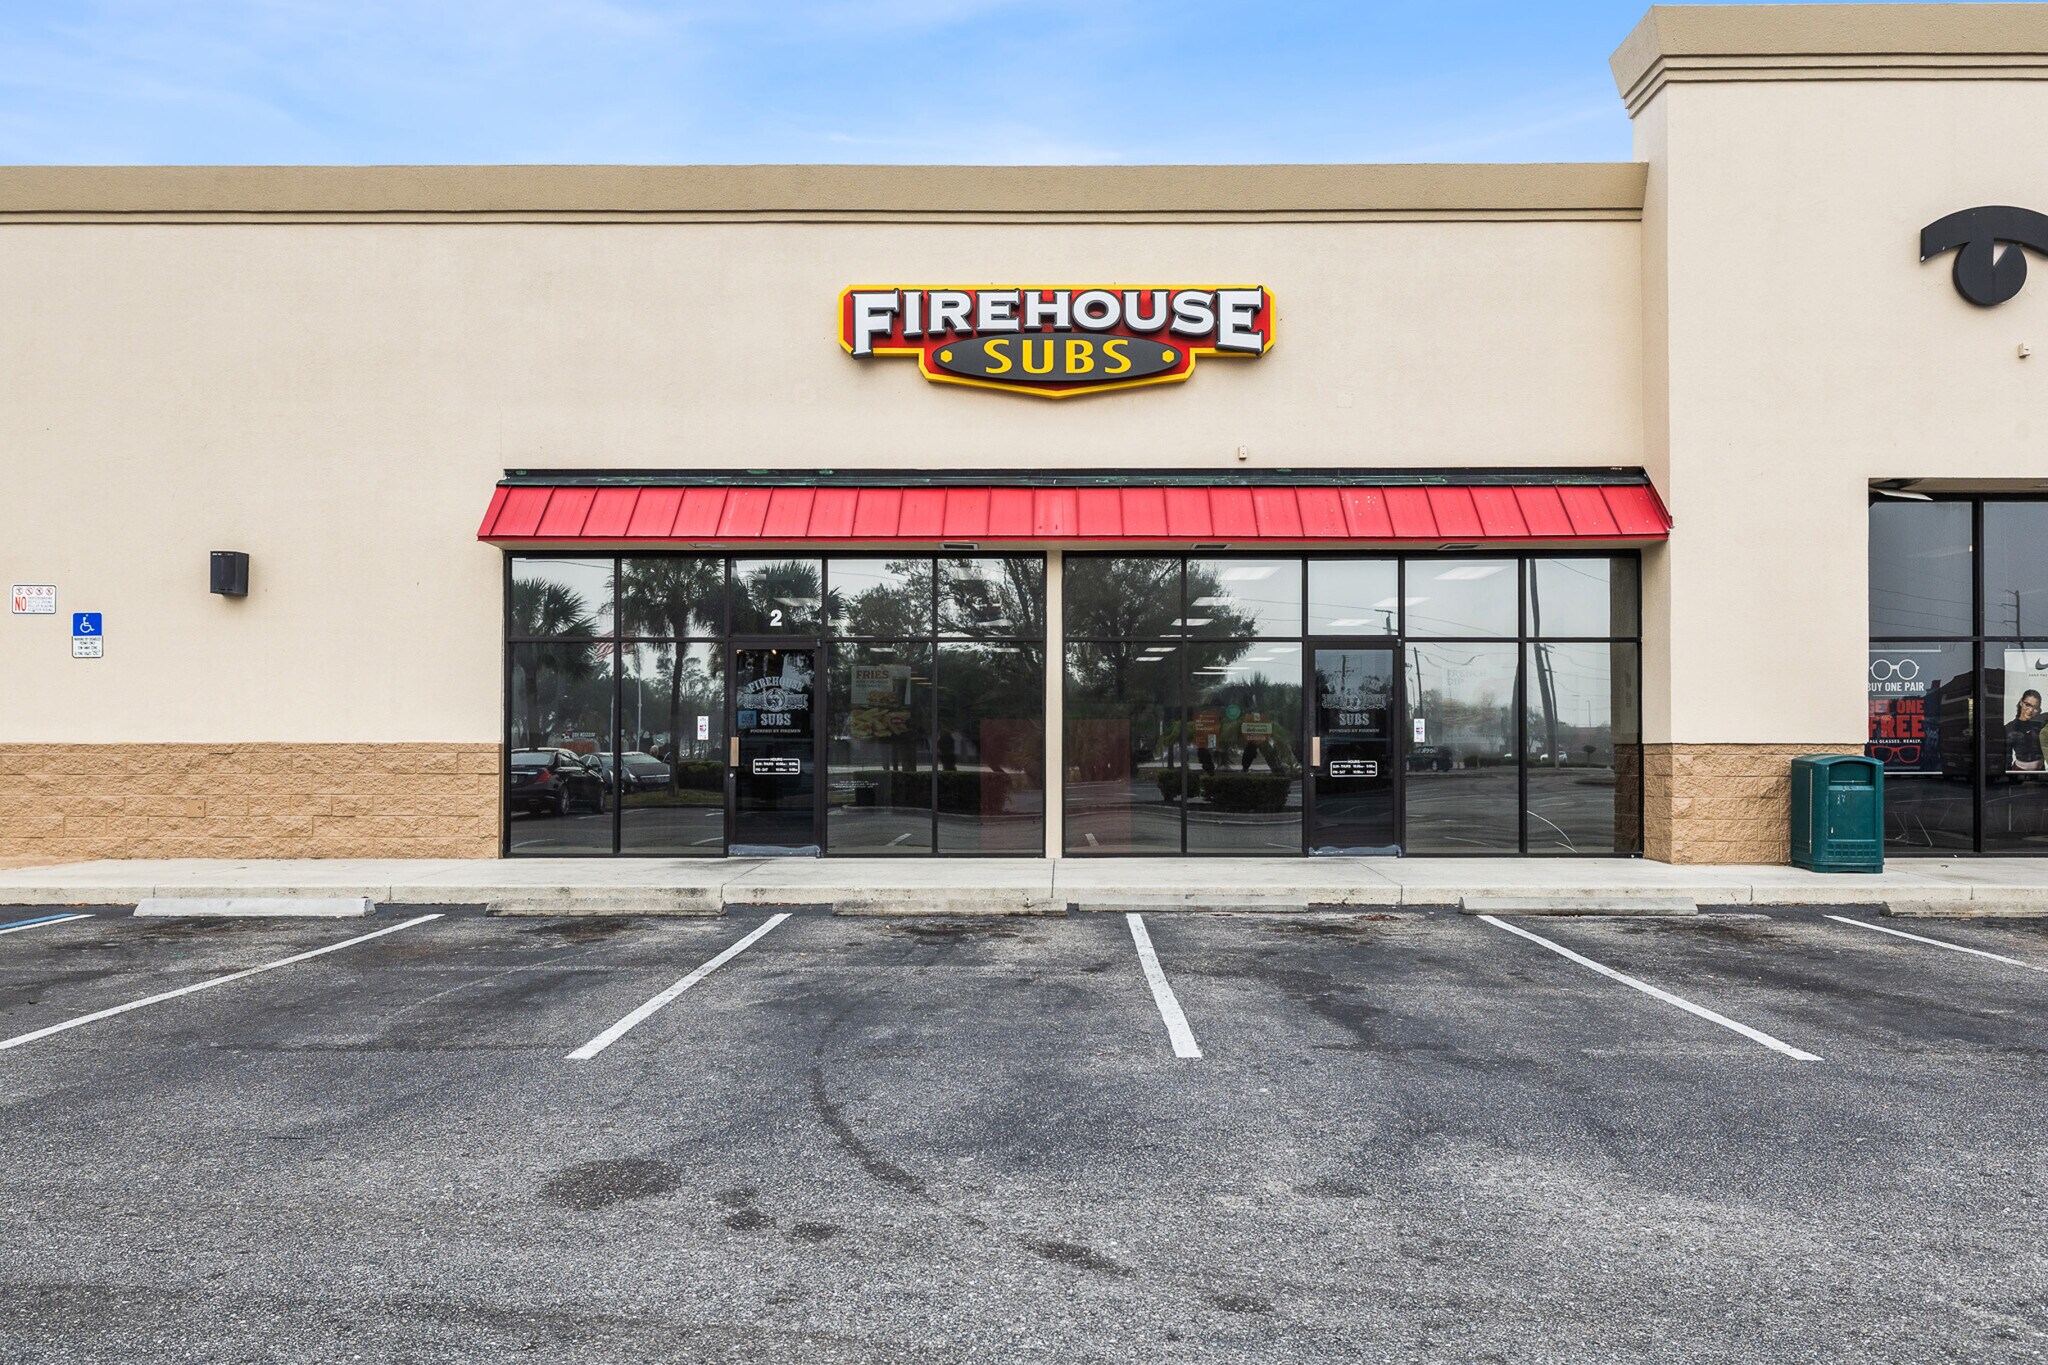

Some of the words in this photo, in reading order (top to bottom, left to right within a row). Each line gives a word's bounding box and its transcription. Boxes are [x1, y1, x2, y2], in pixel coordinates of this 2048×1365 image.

[850, 286, 1264, 359] FIREHOUSE
[983, 339, 1133, 375] SUBS
[15, 596, 27, 611] NO
[769, 609, 783, 627] 2
[856, 670, 889, 679] FRIES
[747, 676, 805, 693] FIREHOUSE
[1885, 682, 1903, 692] ONE
[1904, 682, 1925, 692] PAIR
[1896, 699, 1925, 713] ONE
[760, 713, 791, 726] SUBS
[1339, 712, 1370, 726] SUBS
[1869, 715, 1925, 738] FREE
